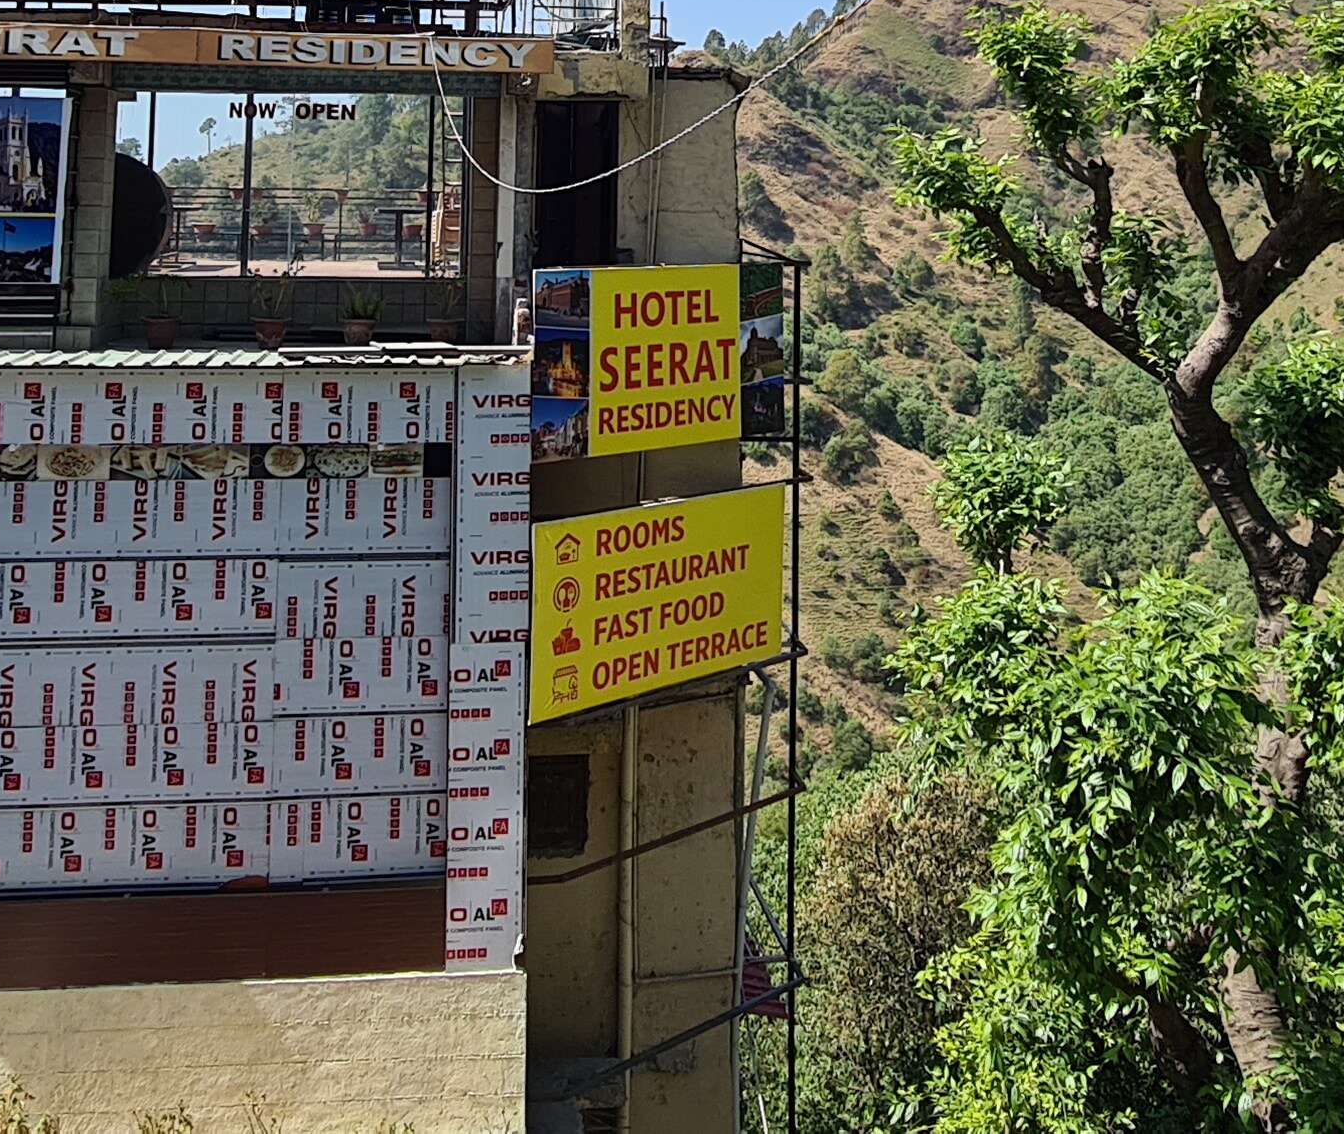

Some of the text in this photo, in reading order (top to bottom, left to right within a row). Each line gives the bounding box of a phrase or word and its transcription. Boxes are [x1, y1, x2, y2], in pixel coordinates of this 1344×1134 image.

[218, 34, 536, 68] RESIDENCY
[229, 102, 356, 120] NOW OPEN
[613, 288, 719, 329] HOTEL
[598, 338, 736, 392] SEERAT
[597, 394, 737, 436] RESIDENCY
[595, 515, 686, 556] ROOMS
[594, 544, 750, 602] RESTAURANT
[593, 591, 725, 647] FAST FOOD
[591, 620, 769, 691] OPEN TERRACE
